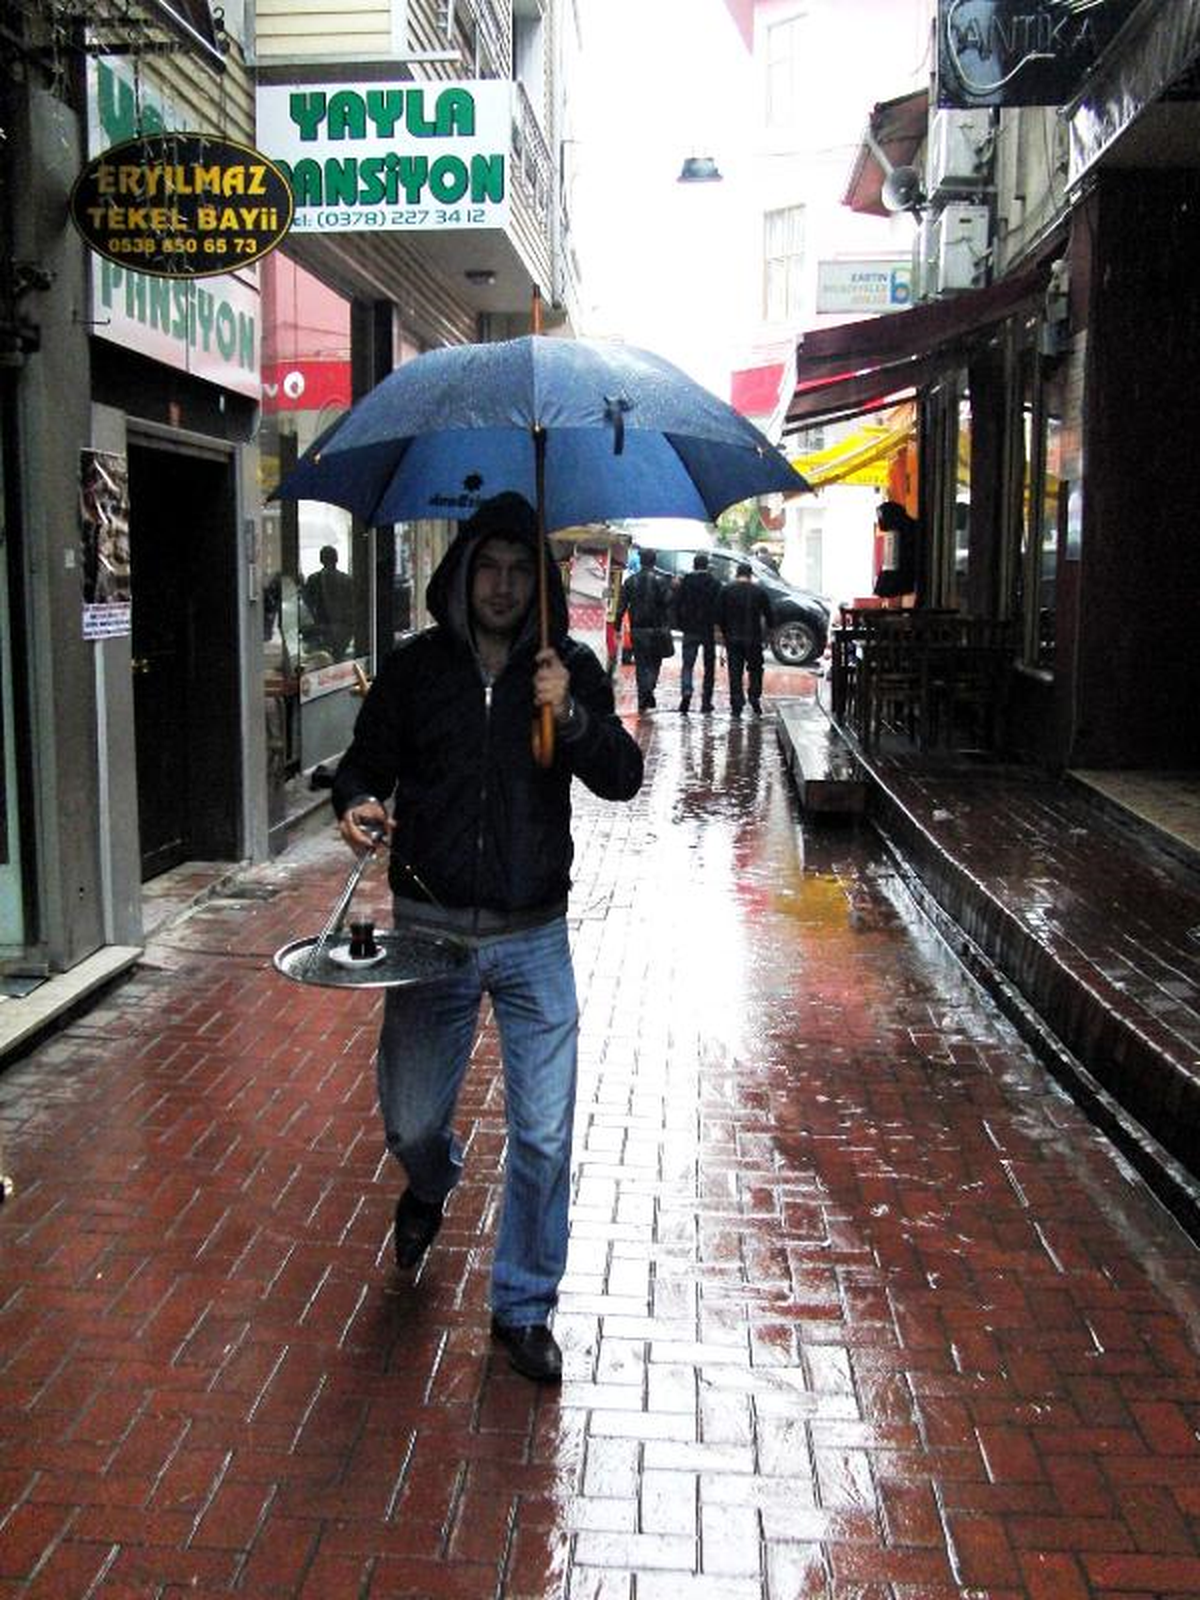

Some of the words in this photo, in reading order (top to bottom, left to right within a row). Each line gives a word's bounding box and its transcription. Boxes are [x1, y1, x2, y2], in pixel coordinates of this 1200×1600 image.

[289, 87, 476, 142] YAYLA
[97, 164, 267, 198] ERYILMAZ
[87, 207, 188, 231] TEKEL
[316, 211, 386, 228] (0378)
[391, 211, 429, 225] 227
[202, 238, 228, 253] 65
[233, 238, 258, 253] 73
